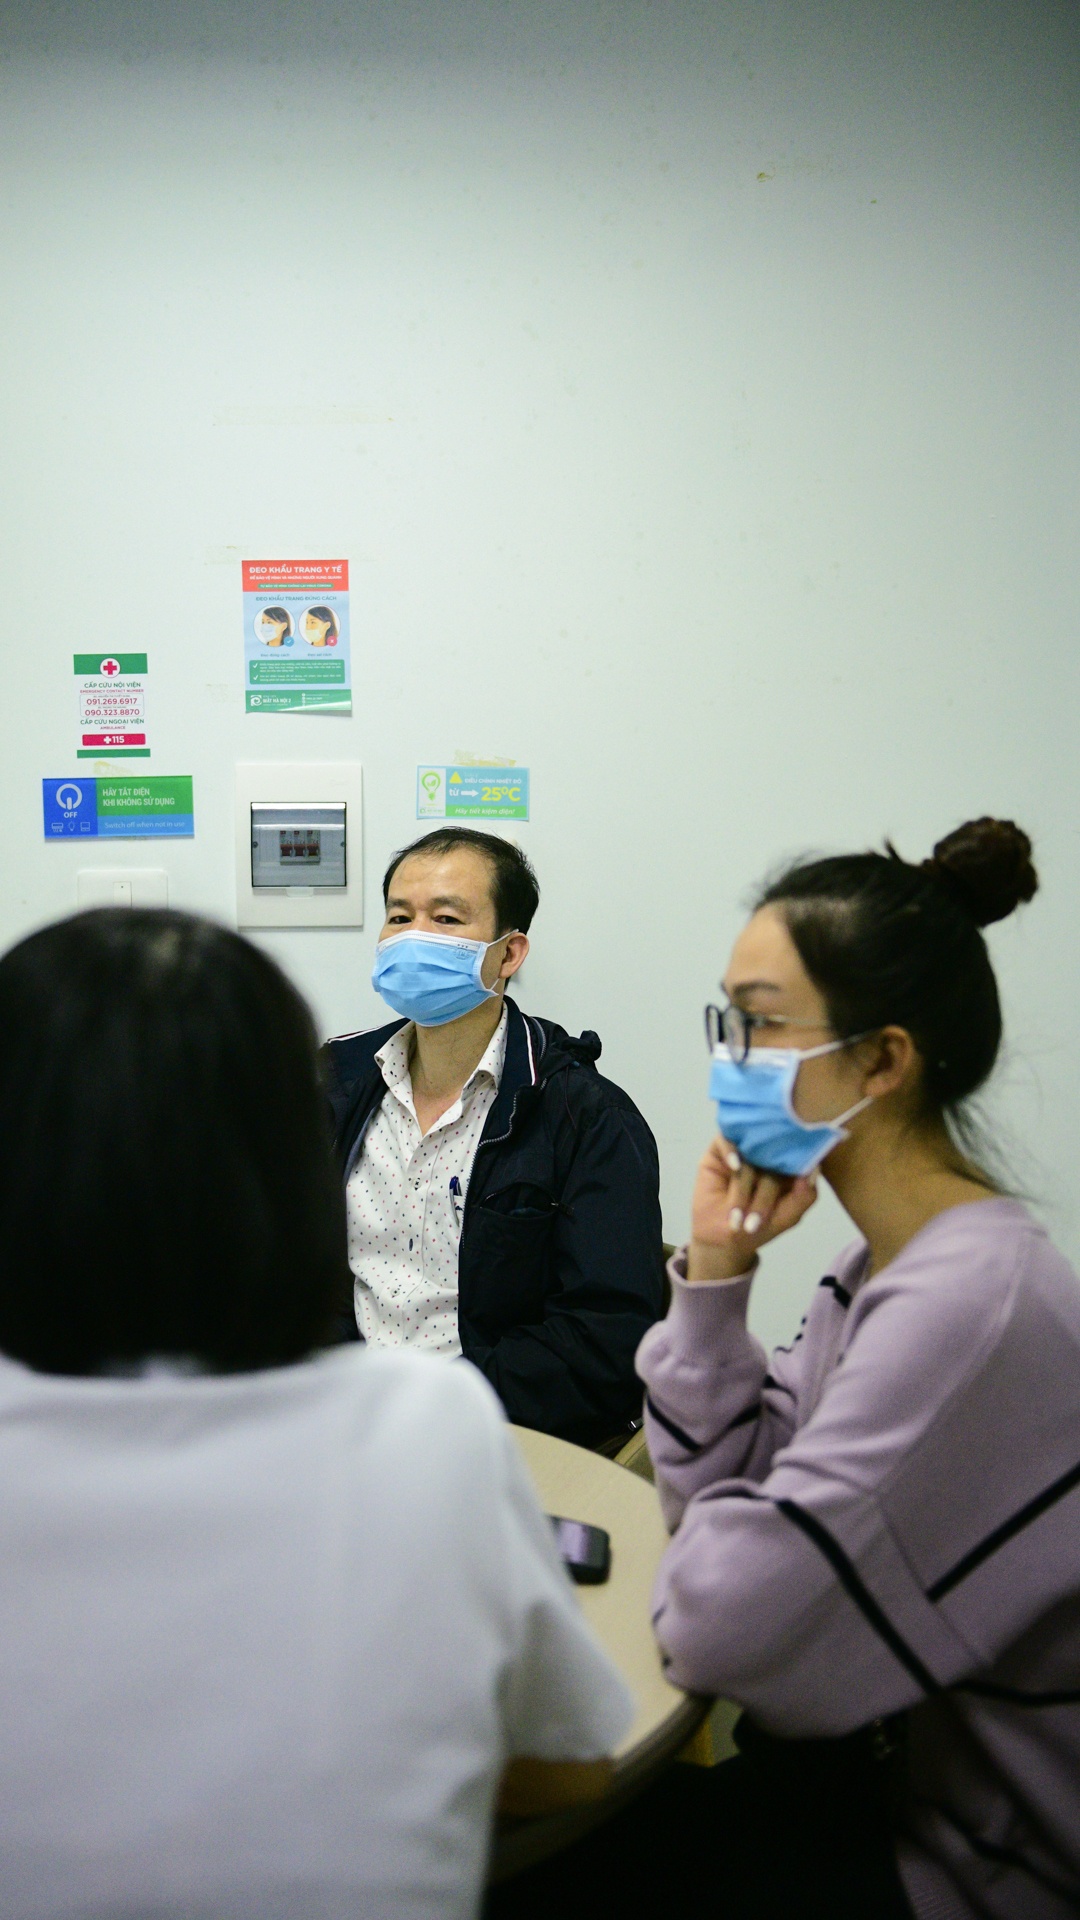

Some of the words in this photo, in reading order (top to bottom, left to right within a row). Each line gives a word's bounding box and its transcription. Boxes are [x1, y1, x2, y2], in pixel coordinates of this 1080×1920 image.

[269, 564, 292, 573] KHẨU
[332, 564, 342, 573] TẾ
[102, 787, 116, 796] HÃY
[118, 787, 131, 796] TẮT
[133, 787, 150, 797] ĐIỆN
[117, 797, 142, 806] KHÔNG
[143, 796, 154, 805] SỬ
[155, 798, 175, 807] DỤNG
